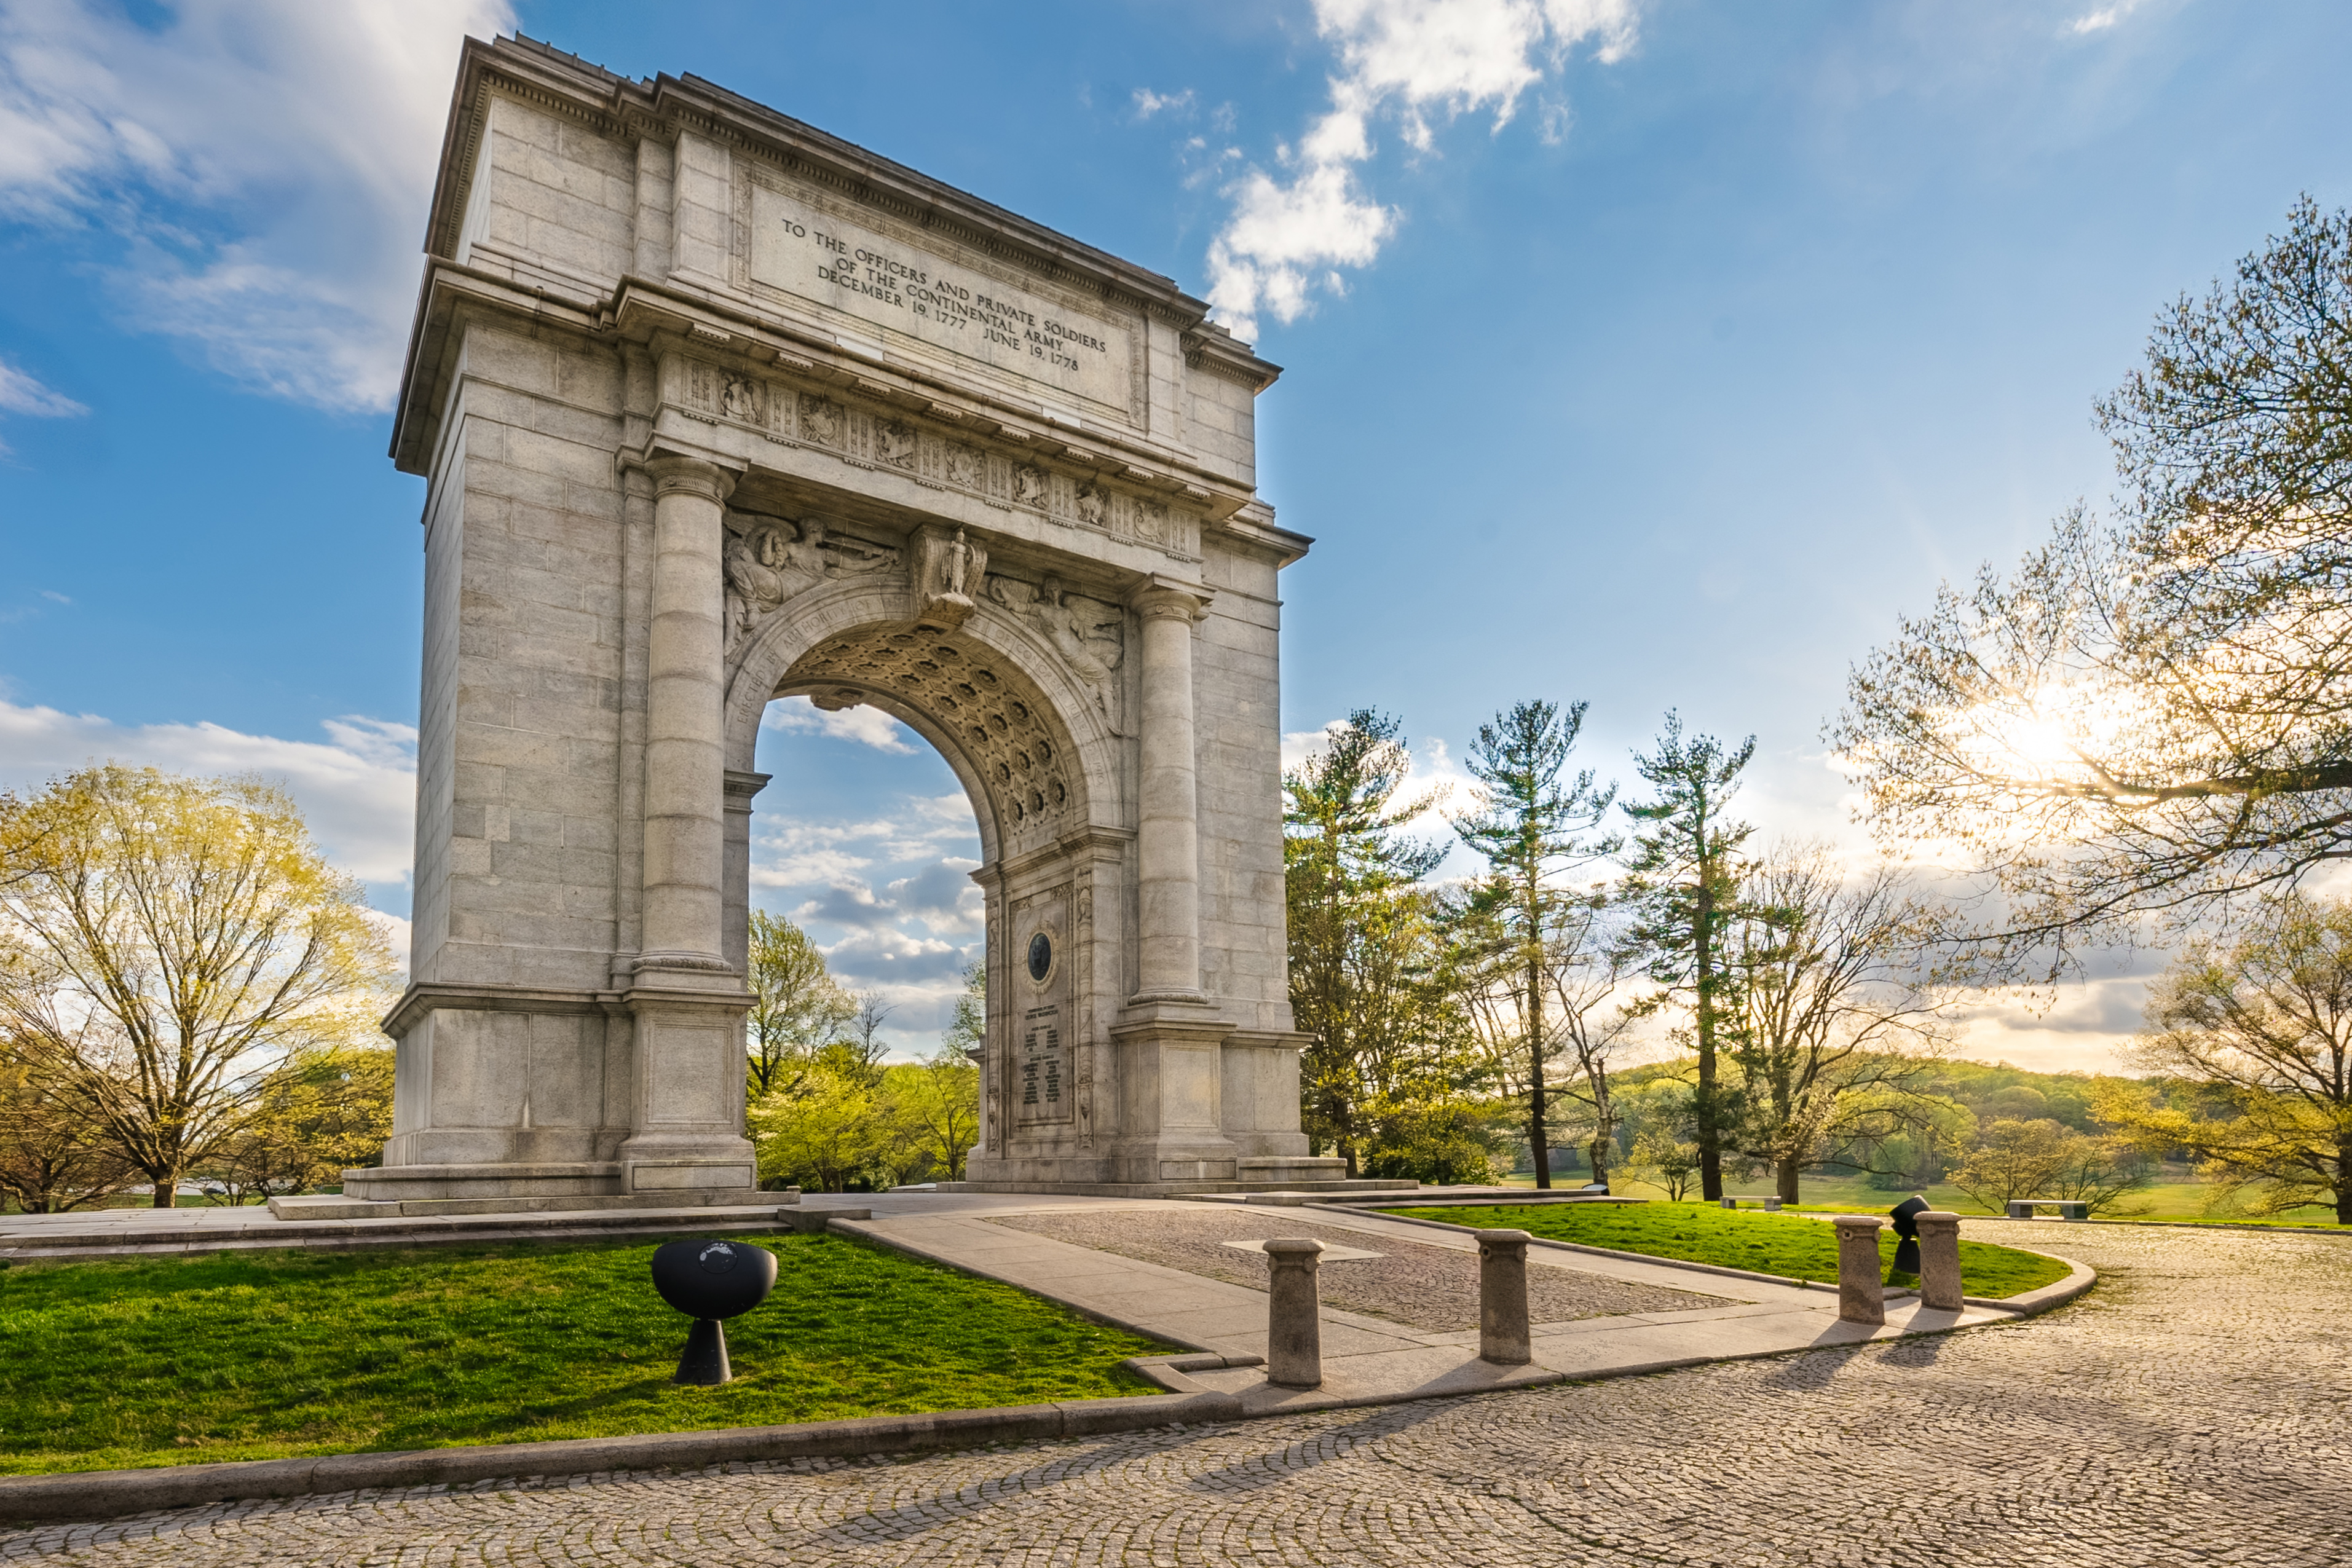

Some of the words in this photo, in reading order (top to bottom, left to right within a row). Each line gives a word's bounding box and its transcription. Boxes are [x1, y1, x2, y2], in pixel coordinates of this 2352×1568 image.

[783, 219, 805, 238] TO
[814, 231, 846, 254] THE
[855, 249, 926, 284] OFFICERS
[935, 280, 969, 301] AND
[977, 294, 1035, 326] PRIVATE
[1044, 320, 1106, 352] SOLDIERS
[818, 265, 903, 307] DECEMBER
[936, 310, 966, 329] 1777
[837, 258, 857, 274] OF
[866, 267, 896, 290] THE
[906, 284, 1016, 334] CONTINENTAL
[1024, 329, 1064, 351] ARMY
[983, 328, 1020, 350] JUNE
[1051, 352, 1078, 371] 1778
[737, 670, 765, 723] ERECTED
[784, 607, 845, 648] AUTHORITY
[996, 629, 1011, 642] OF
[1017, 645, 1066, 696] CONGRESS
